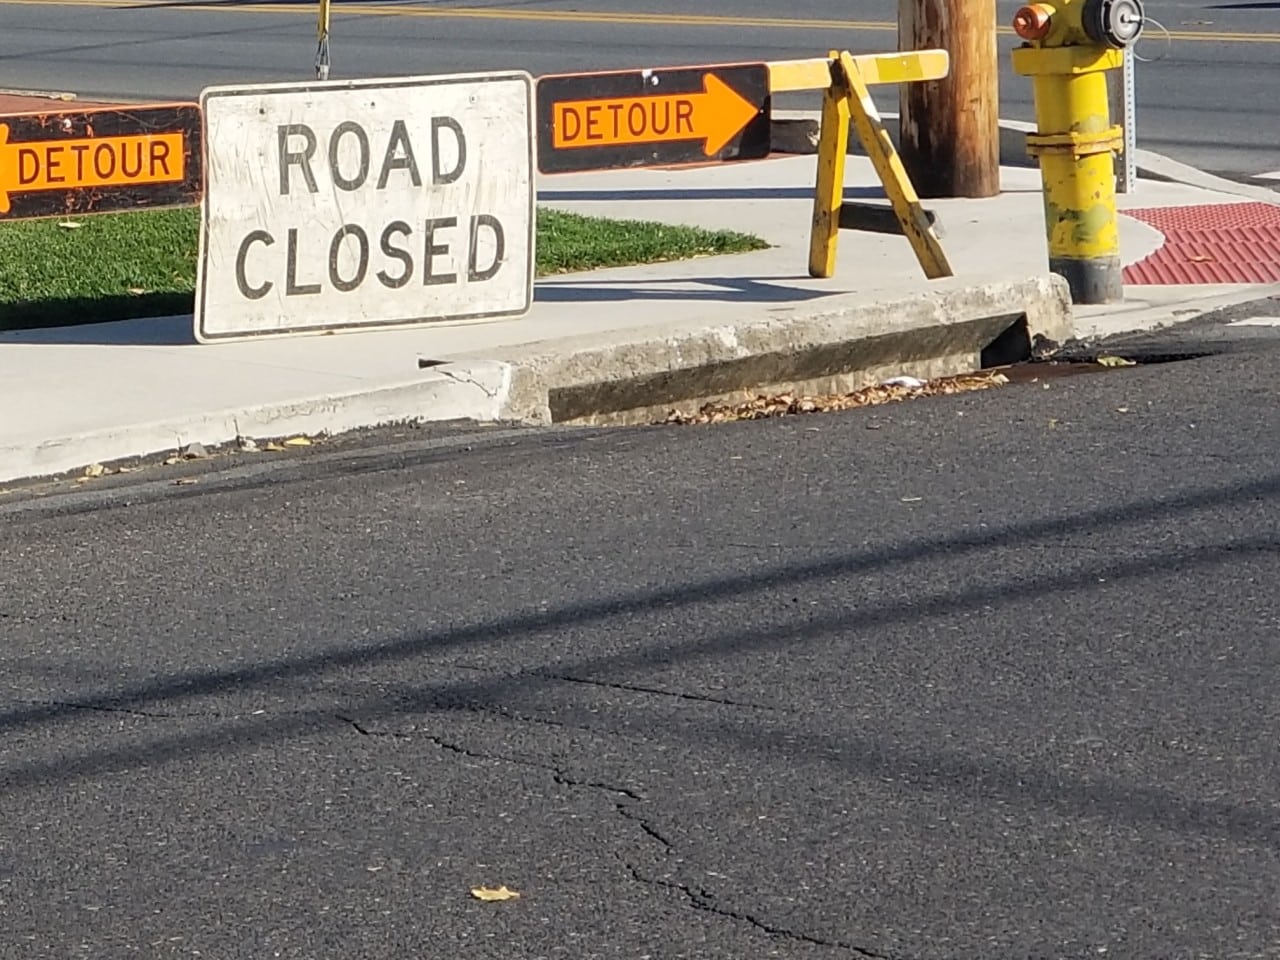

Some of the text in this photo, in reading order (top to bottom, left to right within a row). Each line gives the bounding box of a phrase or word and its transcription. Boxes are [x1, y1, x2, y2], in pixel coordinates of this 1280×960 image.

[562, 99, 694, 142] DETOUR
[18, 140, 170, 185] DETOUR
[277, 116, 467, 195] ROAD
[235, 213, 506, 300] CLOSED
